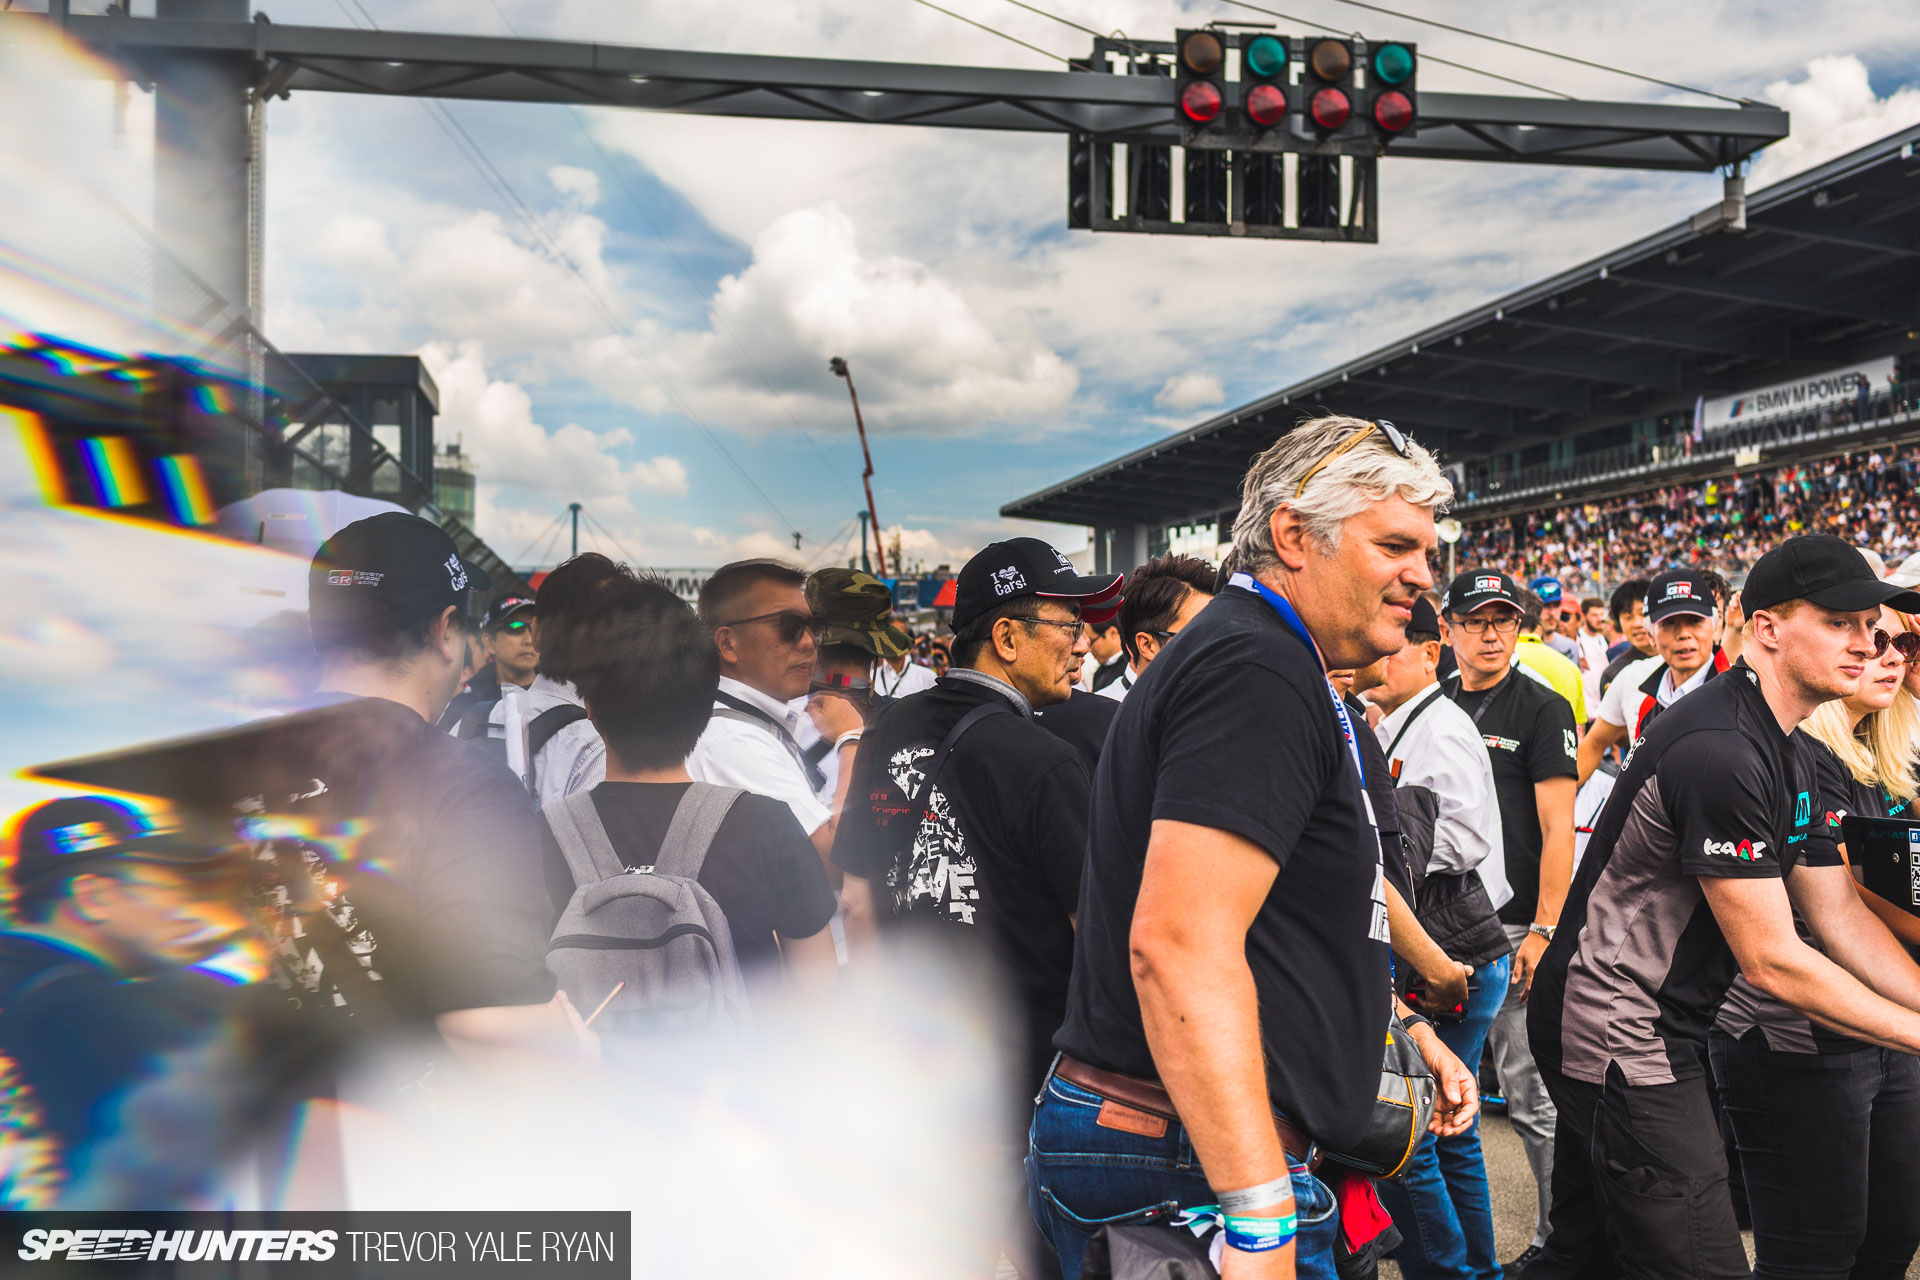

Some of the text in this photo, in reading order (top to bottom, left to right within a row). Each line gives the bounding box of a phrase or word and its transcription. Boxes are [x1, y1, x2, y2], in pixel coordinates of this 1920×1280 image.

[1757, 389, 1791, 411] BMW
[328, 573, 351, 585] GR
[990, 572, 1000, 584] I
[994, 574, 1027, 596] Cars!
